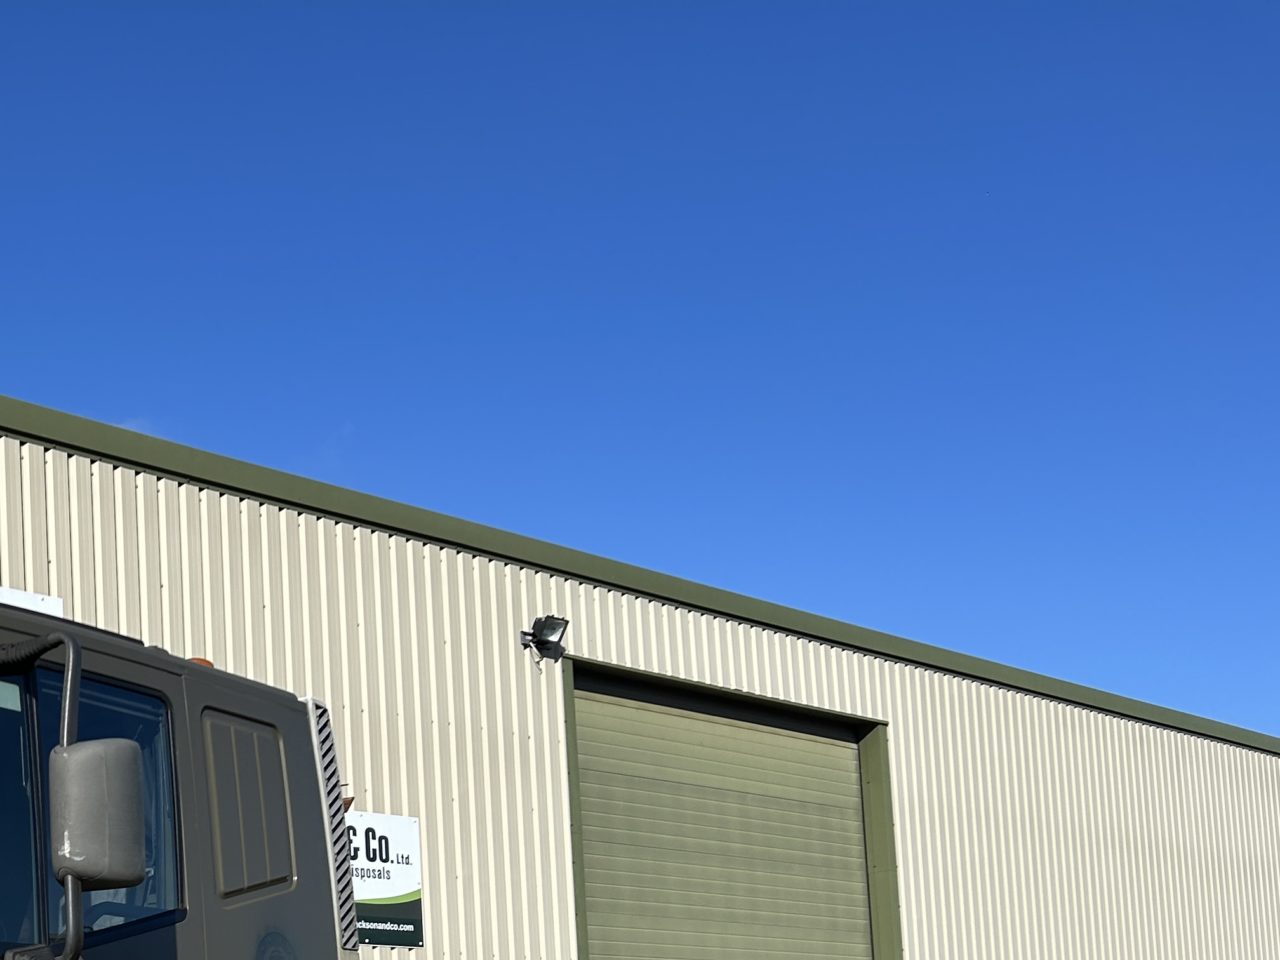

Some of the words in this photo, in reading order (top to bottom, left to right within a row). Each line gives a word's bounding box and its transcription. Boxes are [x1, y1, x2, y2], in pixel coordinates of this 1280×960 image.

[365, 827, 394, 864] Co.
[396, 853, 413, 866] Ltd.
[351, 863, 391, 881] isposals
